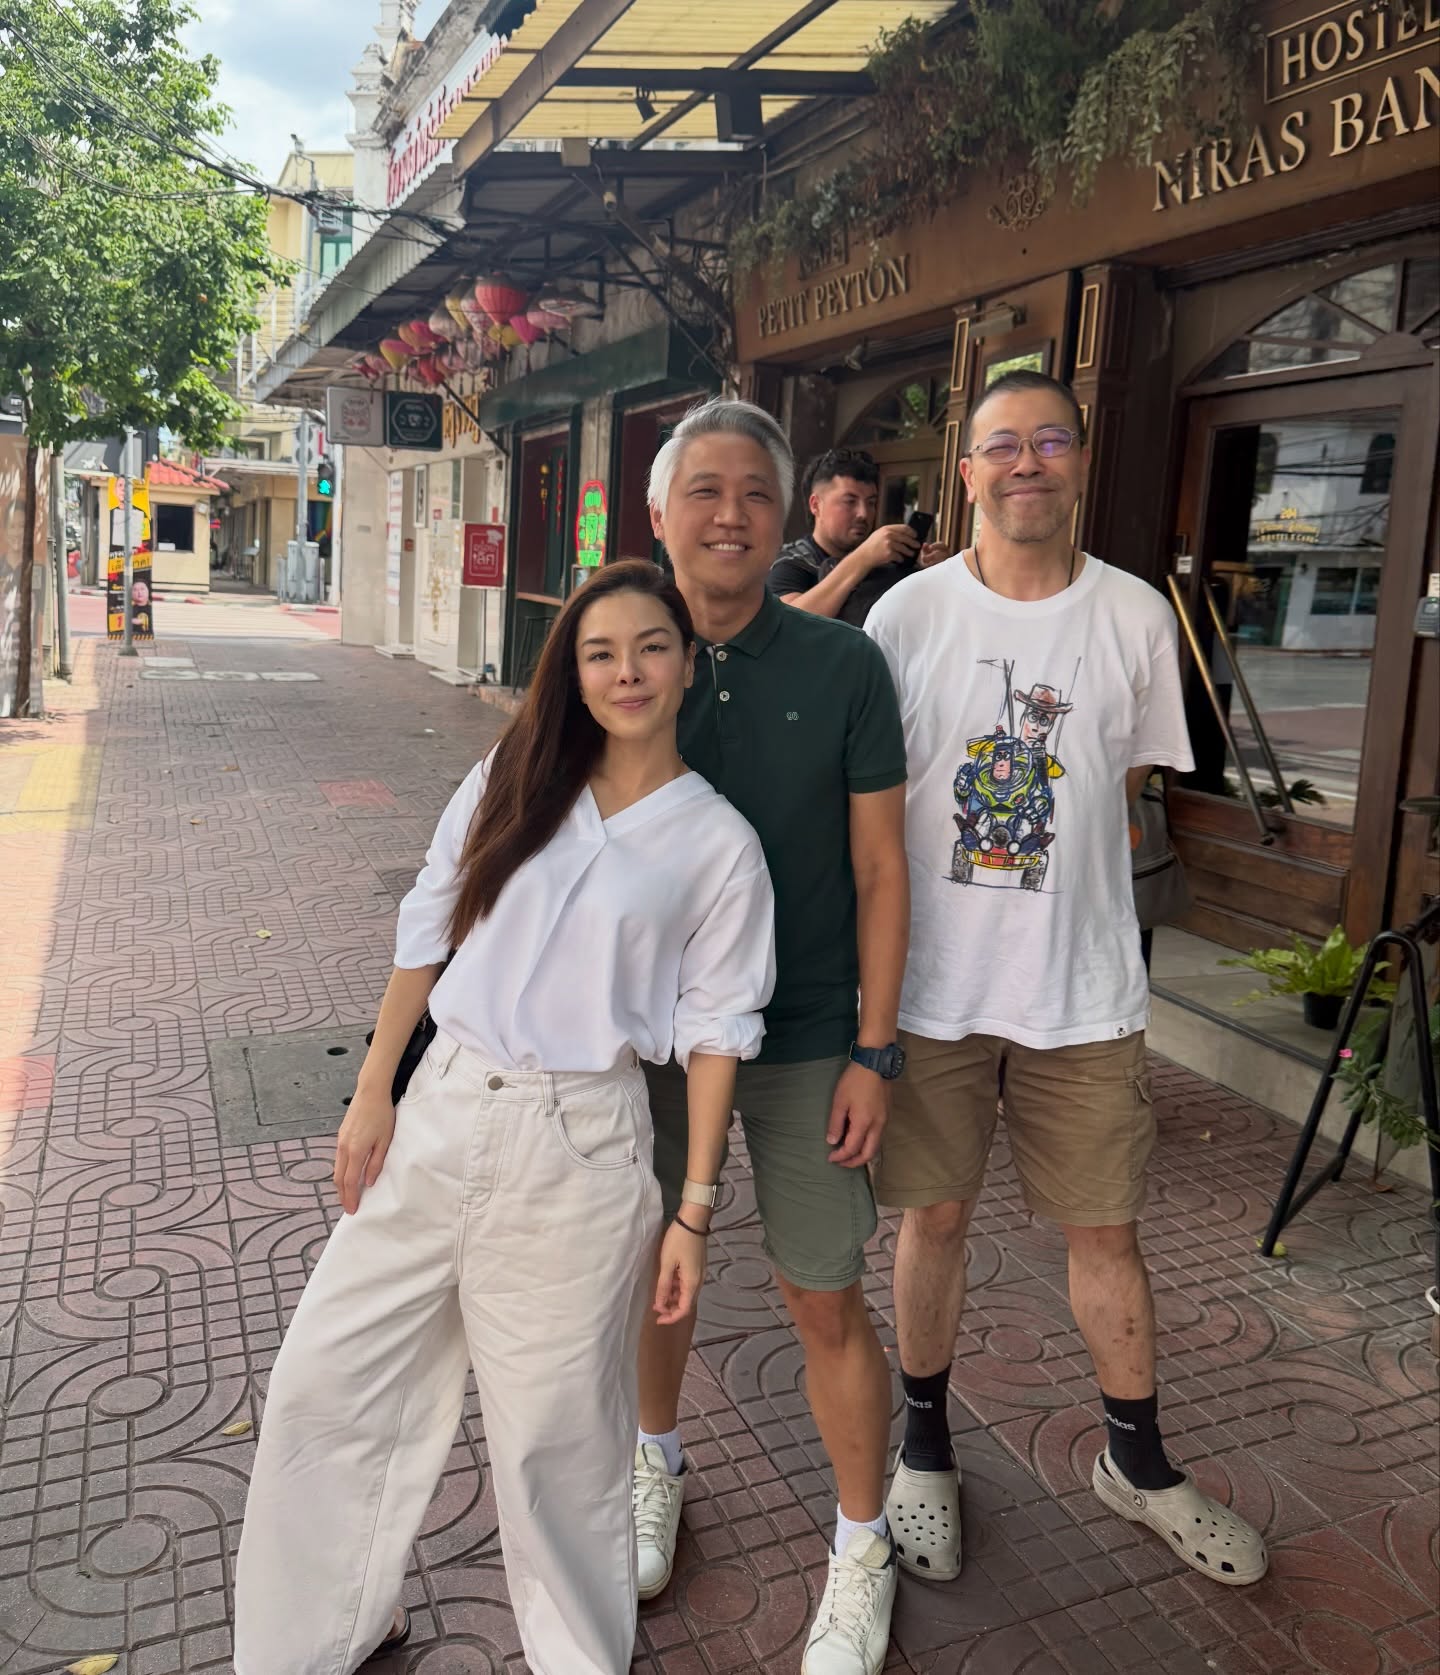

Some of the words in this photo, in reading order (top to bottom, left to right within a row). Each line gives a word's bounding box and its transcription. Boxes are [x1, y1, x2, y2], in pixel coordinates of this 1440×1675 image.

[1152, 111, 1306, 212] NIRAS
[757, 289, 810, 338] PETIT
[814, 253, 911, 321] PEYTON
